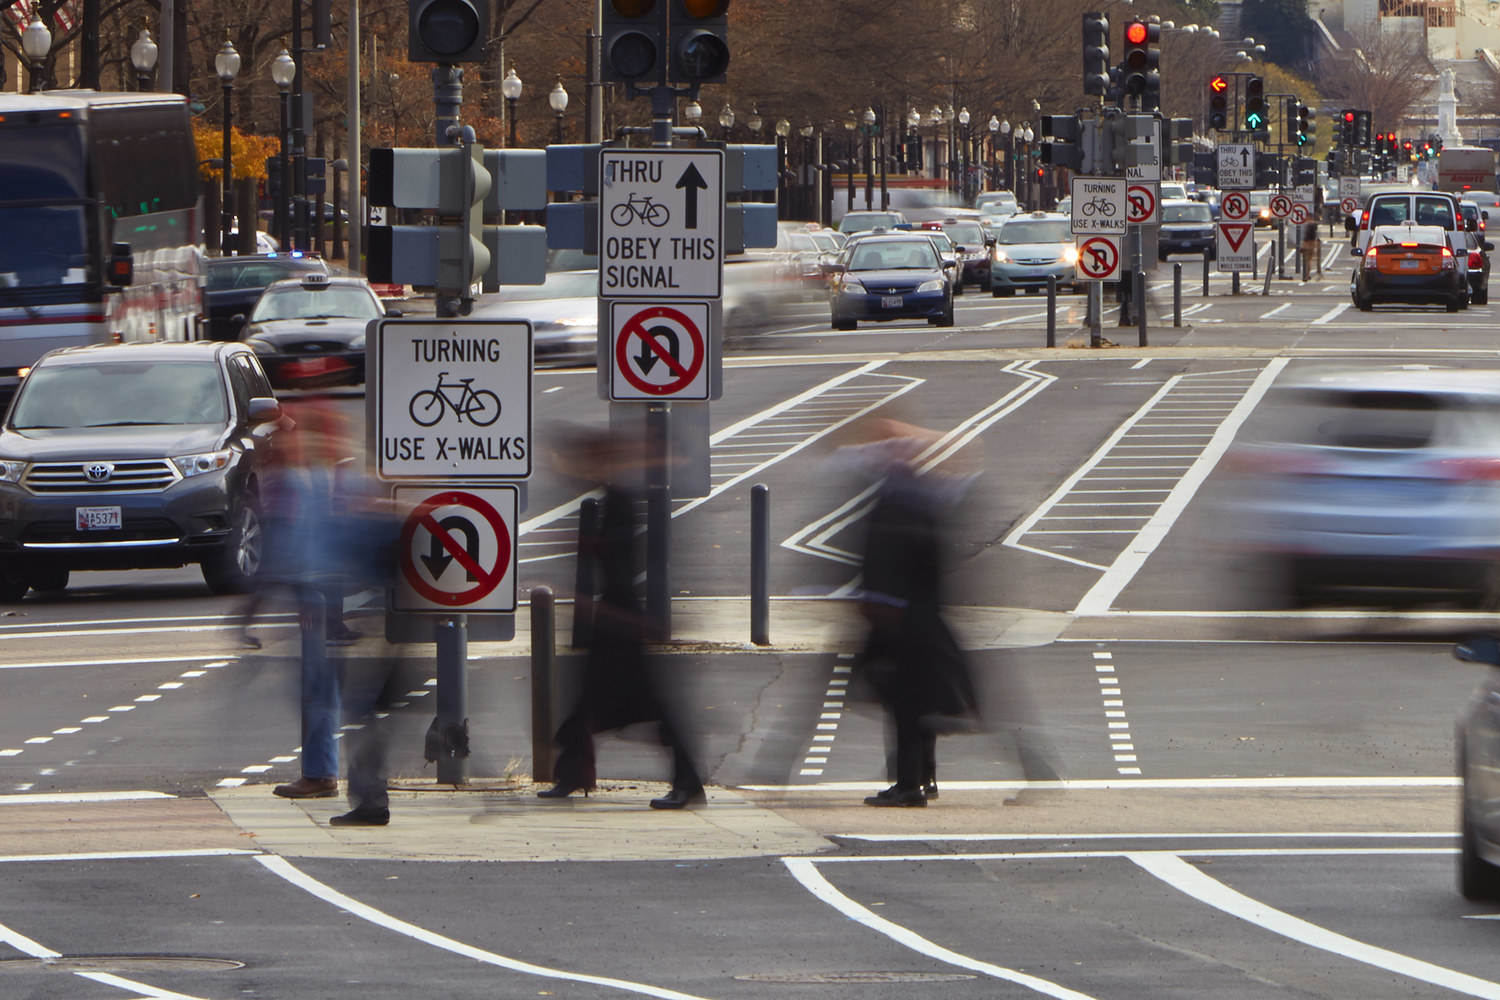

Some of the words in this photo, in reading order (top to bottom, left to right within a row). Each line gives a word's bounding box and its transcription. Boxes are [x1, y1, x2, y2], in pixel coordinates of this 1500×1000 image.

[1220, 146, 1236, 154] THRU
[607, 160, 662, 183] THRU
[1220, 169, 1236, 177] OBEY
[1239, 169, 1253, 177] THIS
[1220, 177, 1242, 185] SIGNAL
[1451, 175, 1484, 183] Annett
[1084, 184, 1116, 193] TURNING
[1073, 219, 1088, 228] USE
[1091, 219, 1124, 228] X-WALKS
[606, 237, 661, 259] OBEY
[670, 238, 715, 260] THIS
[606, 265, 680, 288] SIGNAL
[411, 338, 500, 363] TURNING
[385, 437, 425, 461] USE
[436, 436, 526, 461] X-WALKS
